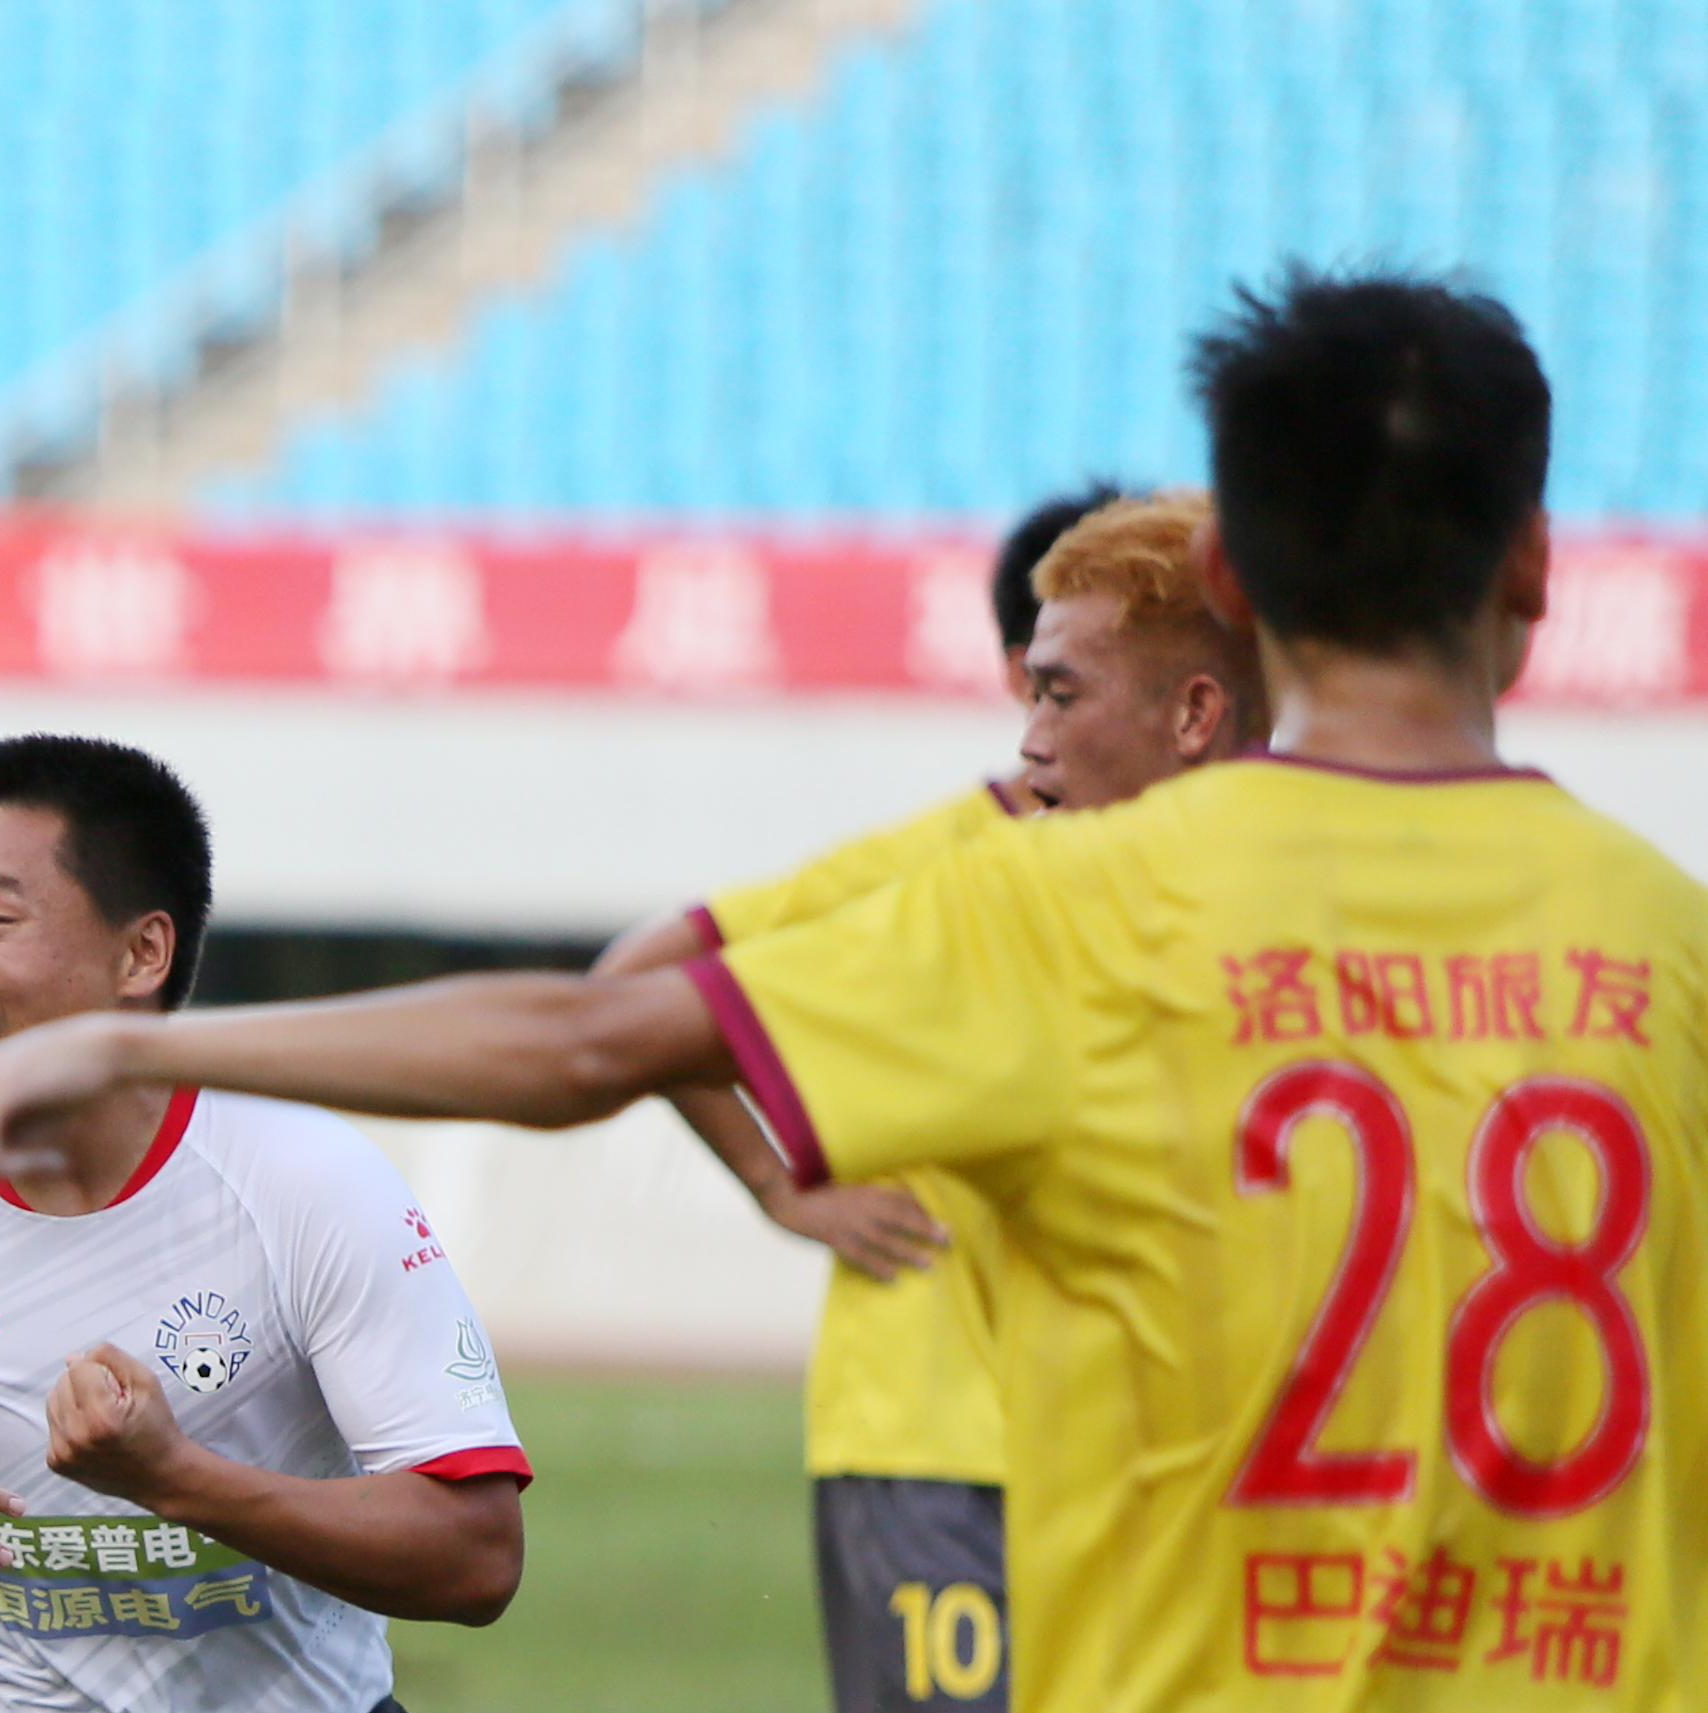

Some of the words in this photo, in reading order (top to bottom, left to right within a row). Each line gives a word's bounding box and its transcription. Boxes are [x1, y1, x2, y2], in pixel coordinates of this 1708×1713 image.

[1220, 947, 1652, 1048] 洛阳旅发
[401, 1244, 447, 1273] KEL
[1221, 1057, 1653, 1521] 28
[888, 1580, 1002, 1703] 10
[1244, 1545, 1628, 1688] 巴迪瑞
